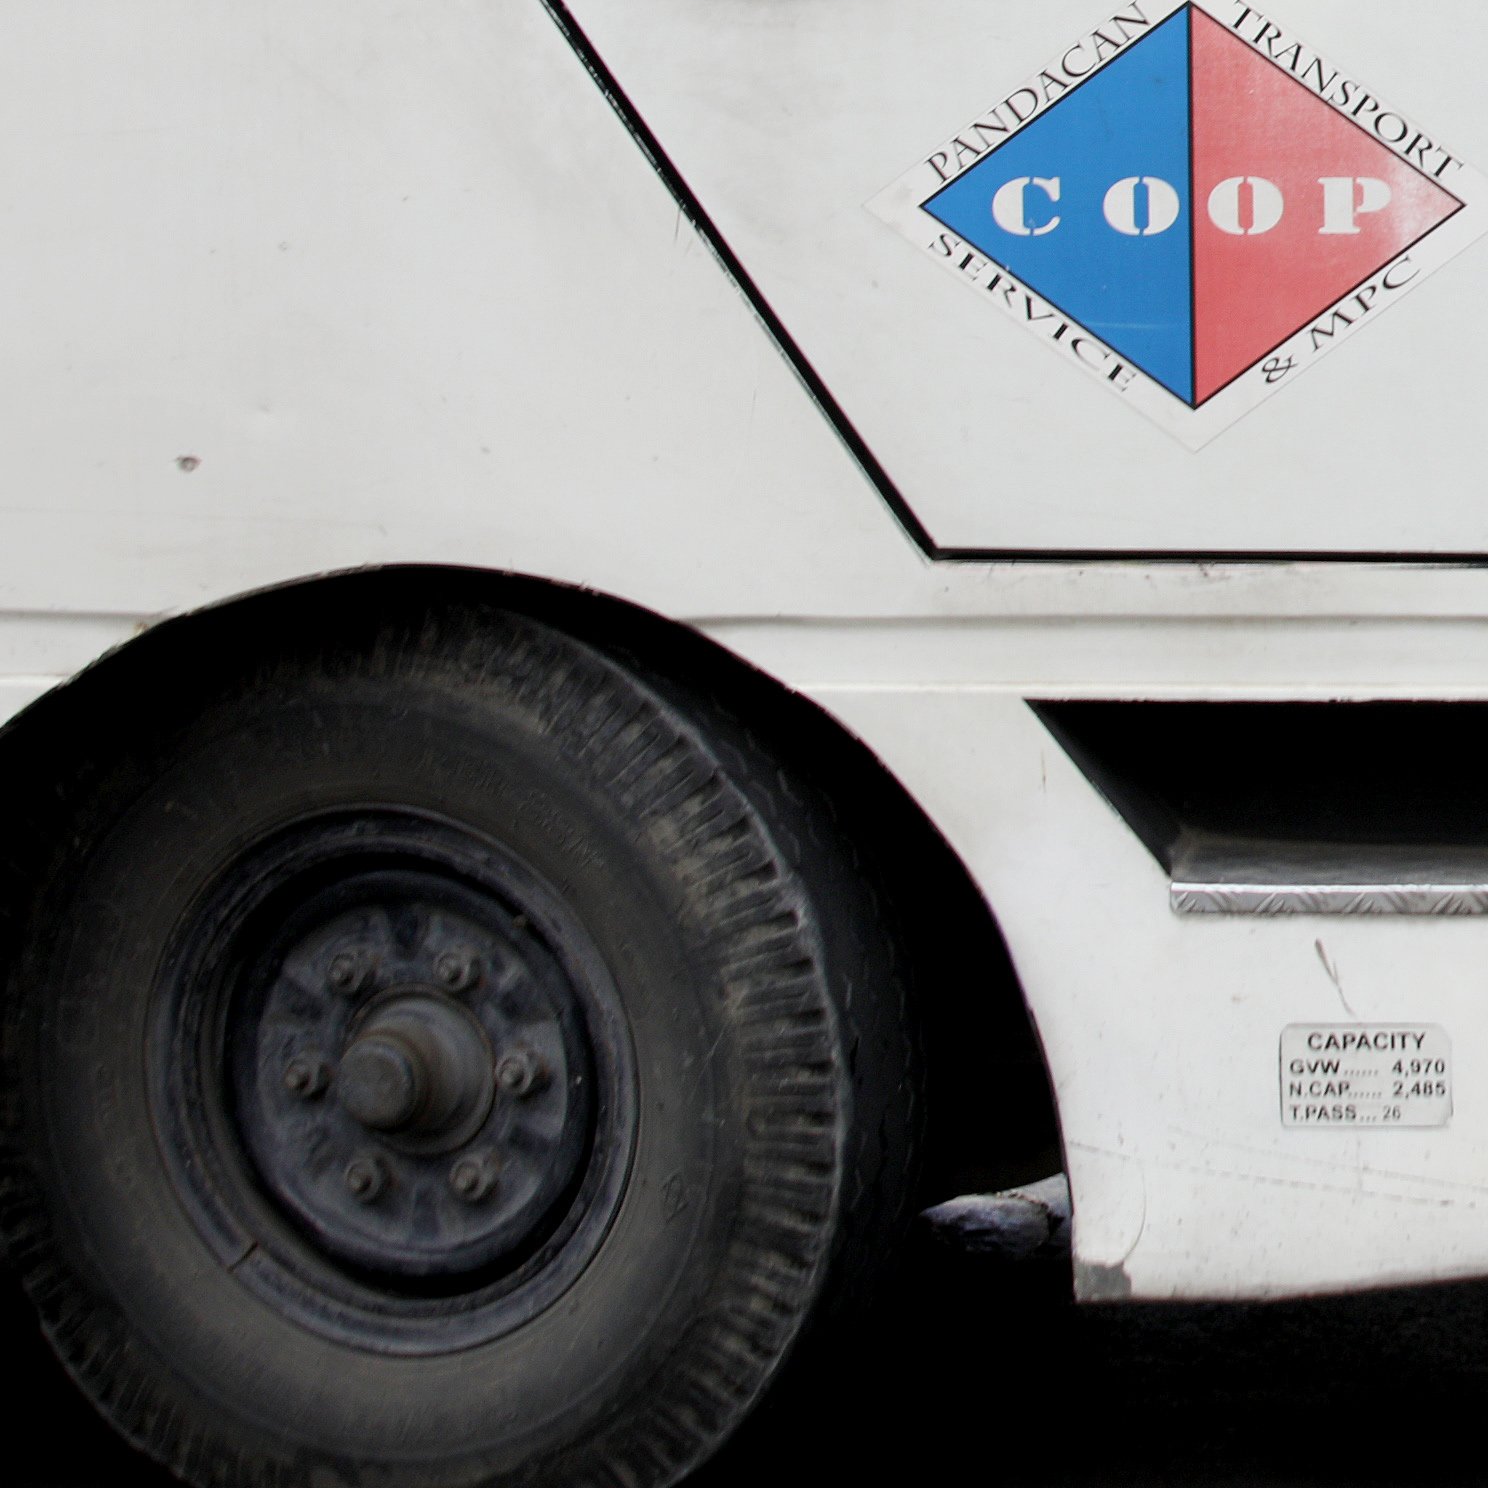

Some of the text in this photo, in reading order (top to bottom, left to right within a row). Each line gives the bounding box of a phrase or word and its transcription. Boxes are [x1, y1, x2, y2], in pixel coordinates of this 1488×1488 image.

[924, 0, 1153, 185] PANDACAN
[991, 175, 1393, 237] COOP
[927, 232, 1137, 394] SERVICE
[1260, 255, 1422, 385] & MPC
[1307, 1031, 1427, 1052] CAPACITY
[1391, 1058, 1446, 1077] 4,970
[1392, 1080, 1447, 1099] 2,485
[1382, 1104, 1402, 1121] 26
